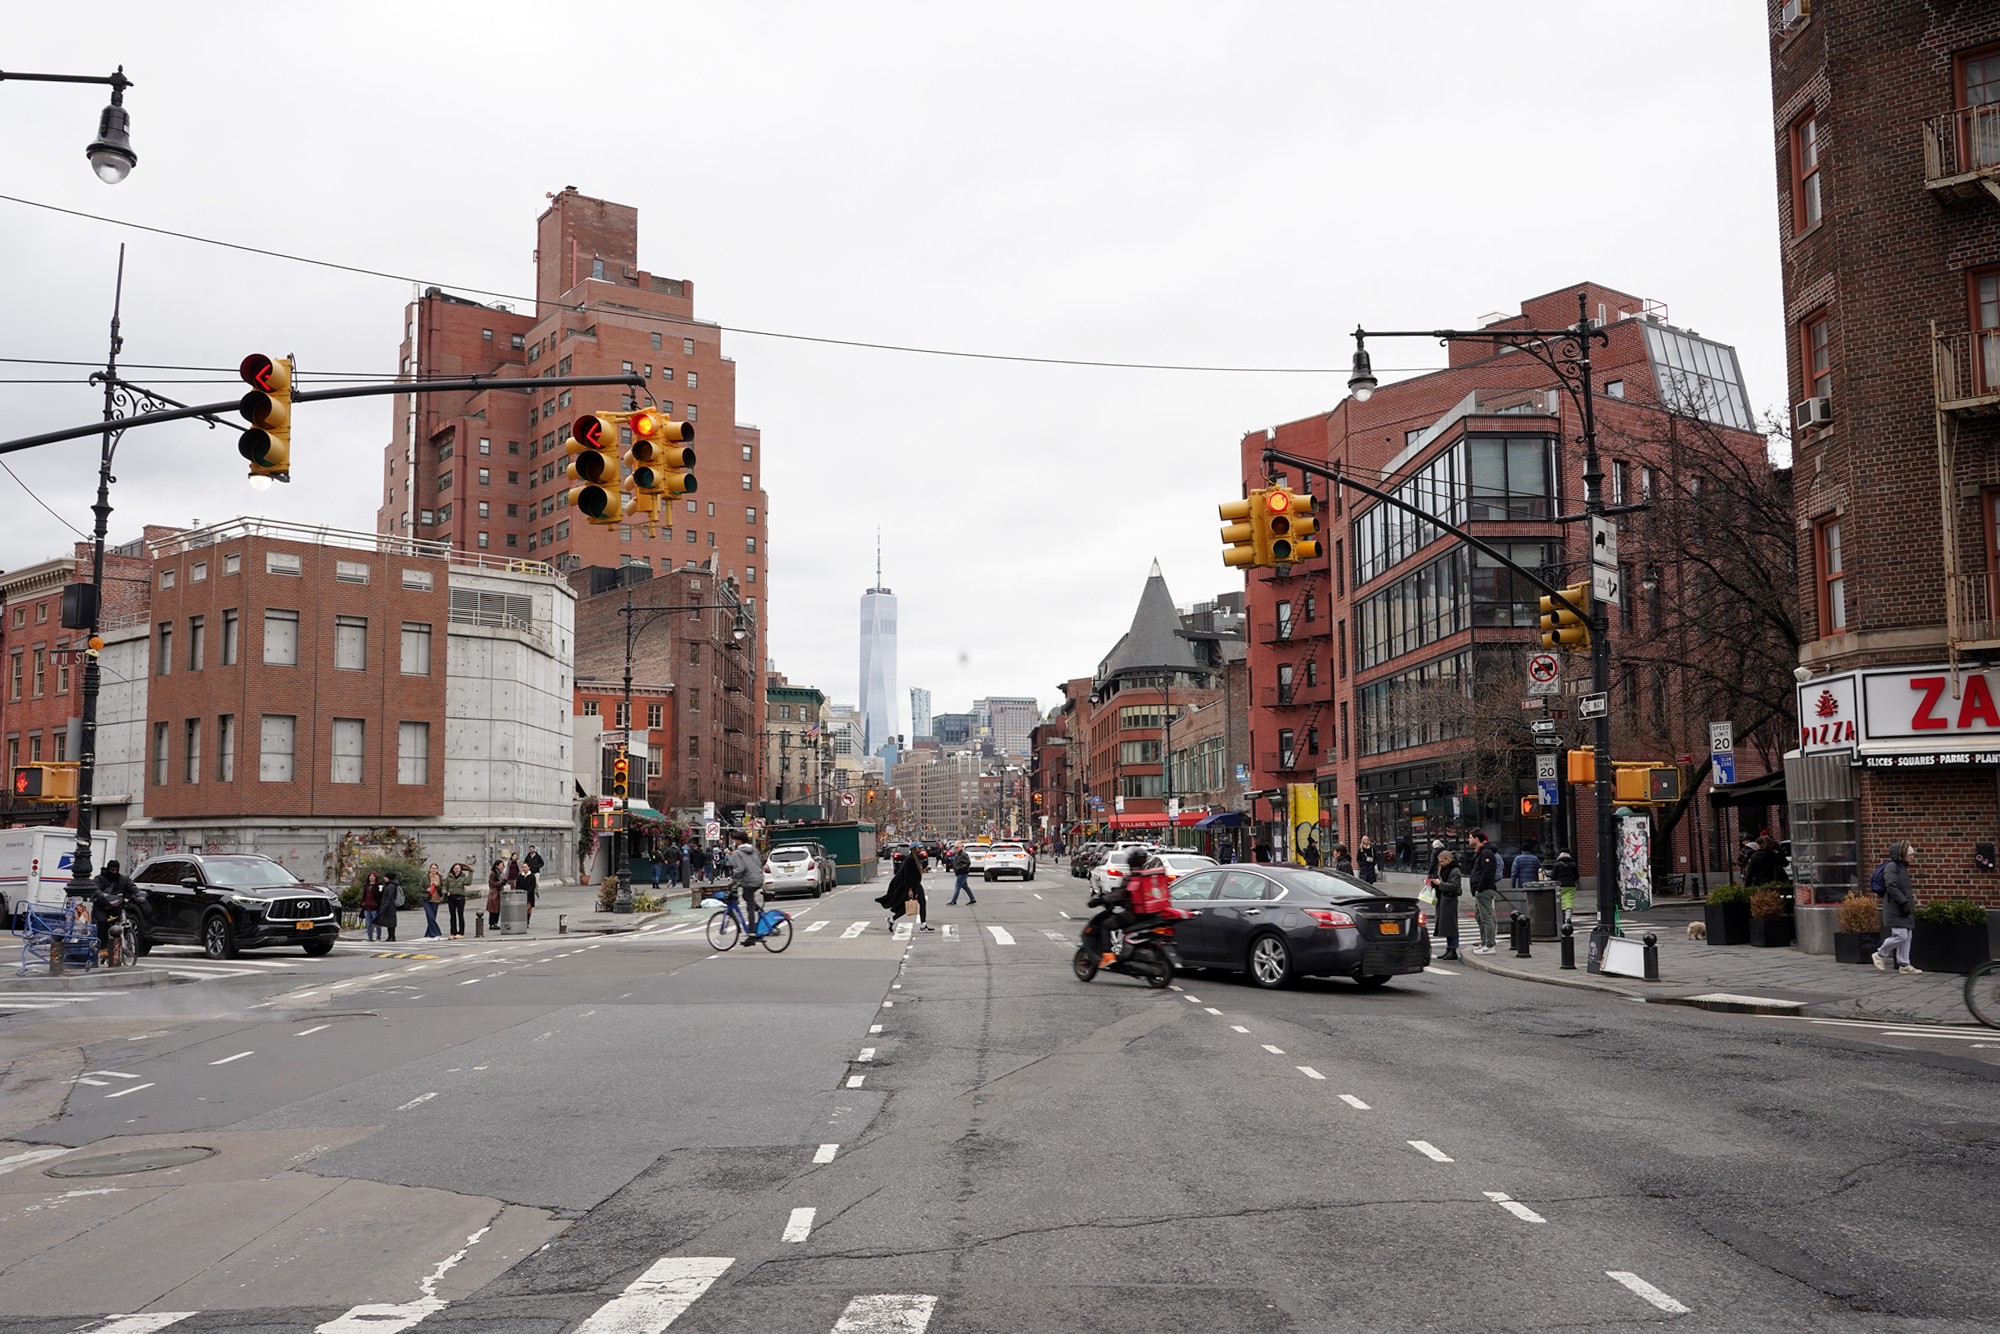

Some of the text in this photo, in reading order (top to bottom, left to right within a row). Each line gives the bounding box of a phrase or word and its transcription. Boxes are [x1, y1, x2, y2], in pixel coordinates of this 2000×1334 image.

[1595, 577, 1608, 590] LOCAL
[50, 653, 58, 665] W
[61, 653, 68, 665] 11
[1582, 700, 1603, 711] ONE WAY
[1910, 675, 2000, 730] ZA
[1801, 720, 1855, 746] PIZZA
[1714, 738, 1730, 749] 20
[1866, 757, 1893, 767] SLICES
[1897, 755, 1935, 767] SQUARES
[1939, 753, 1970, 764] PARMS
[1540, 767, 1555, 777] 20
